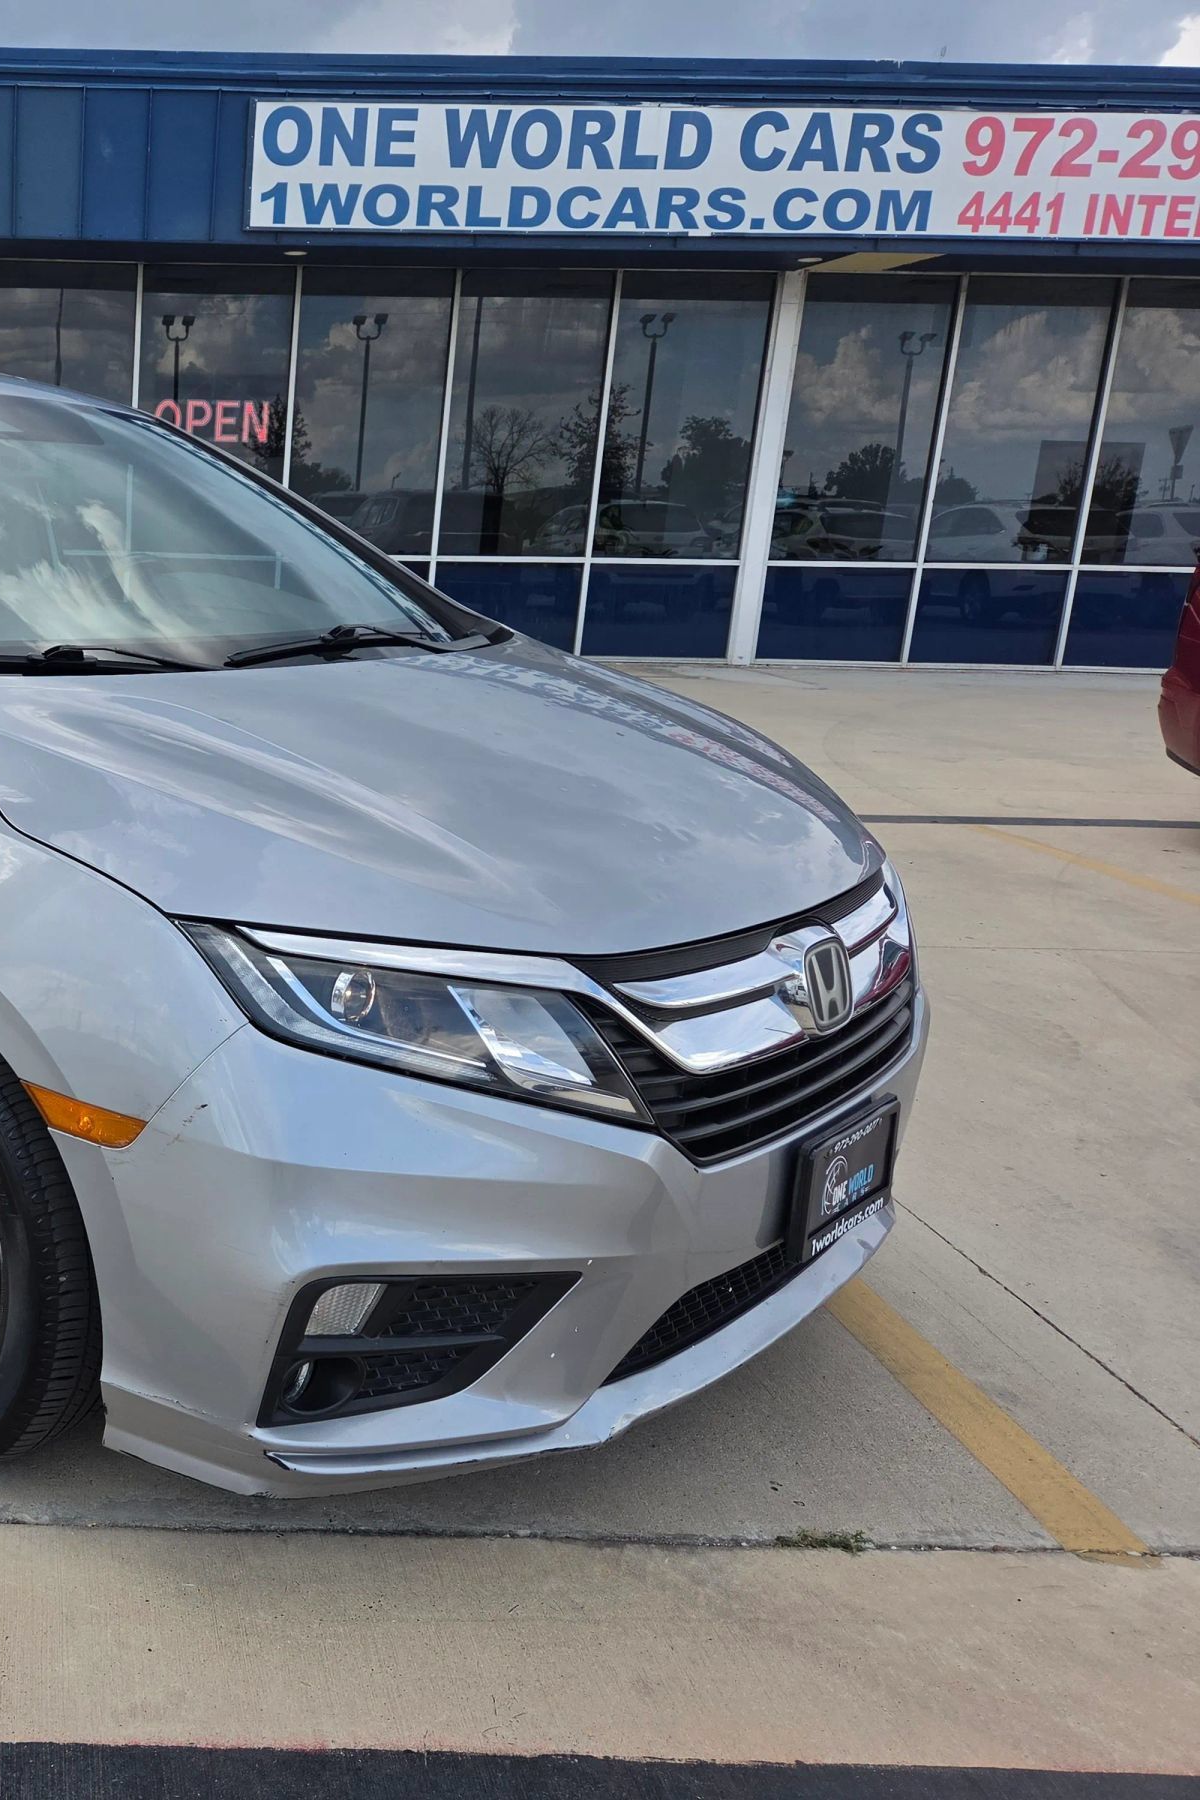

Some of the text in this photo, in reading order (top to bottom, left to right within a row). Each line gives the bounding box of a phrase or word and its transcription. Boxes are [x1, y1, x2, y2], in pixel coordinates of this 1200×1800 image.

[262, 106, 943, 174] ONE WORLD CARS
[260, 181, 933, 231] 1WORLDCARS.COM
[957, 191, 1200, 238] 4441 INTE
[155, 399, 270, 442] OPEN
[832, 1163, 874, 1206] ONE WORLD
[811, 1197, 884, 1256] 1worldcars.com
